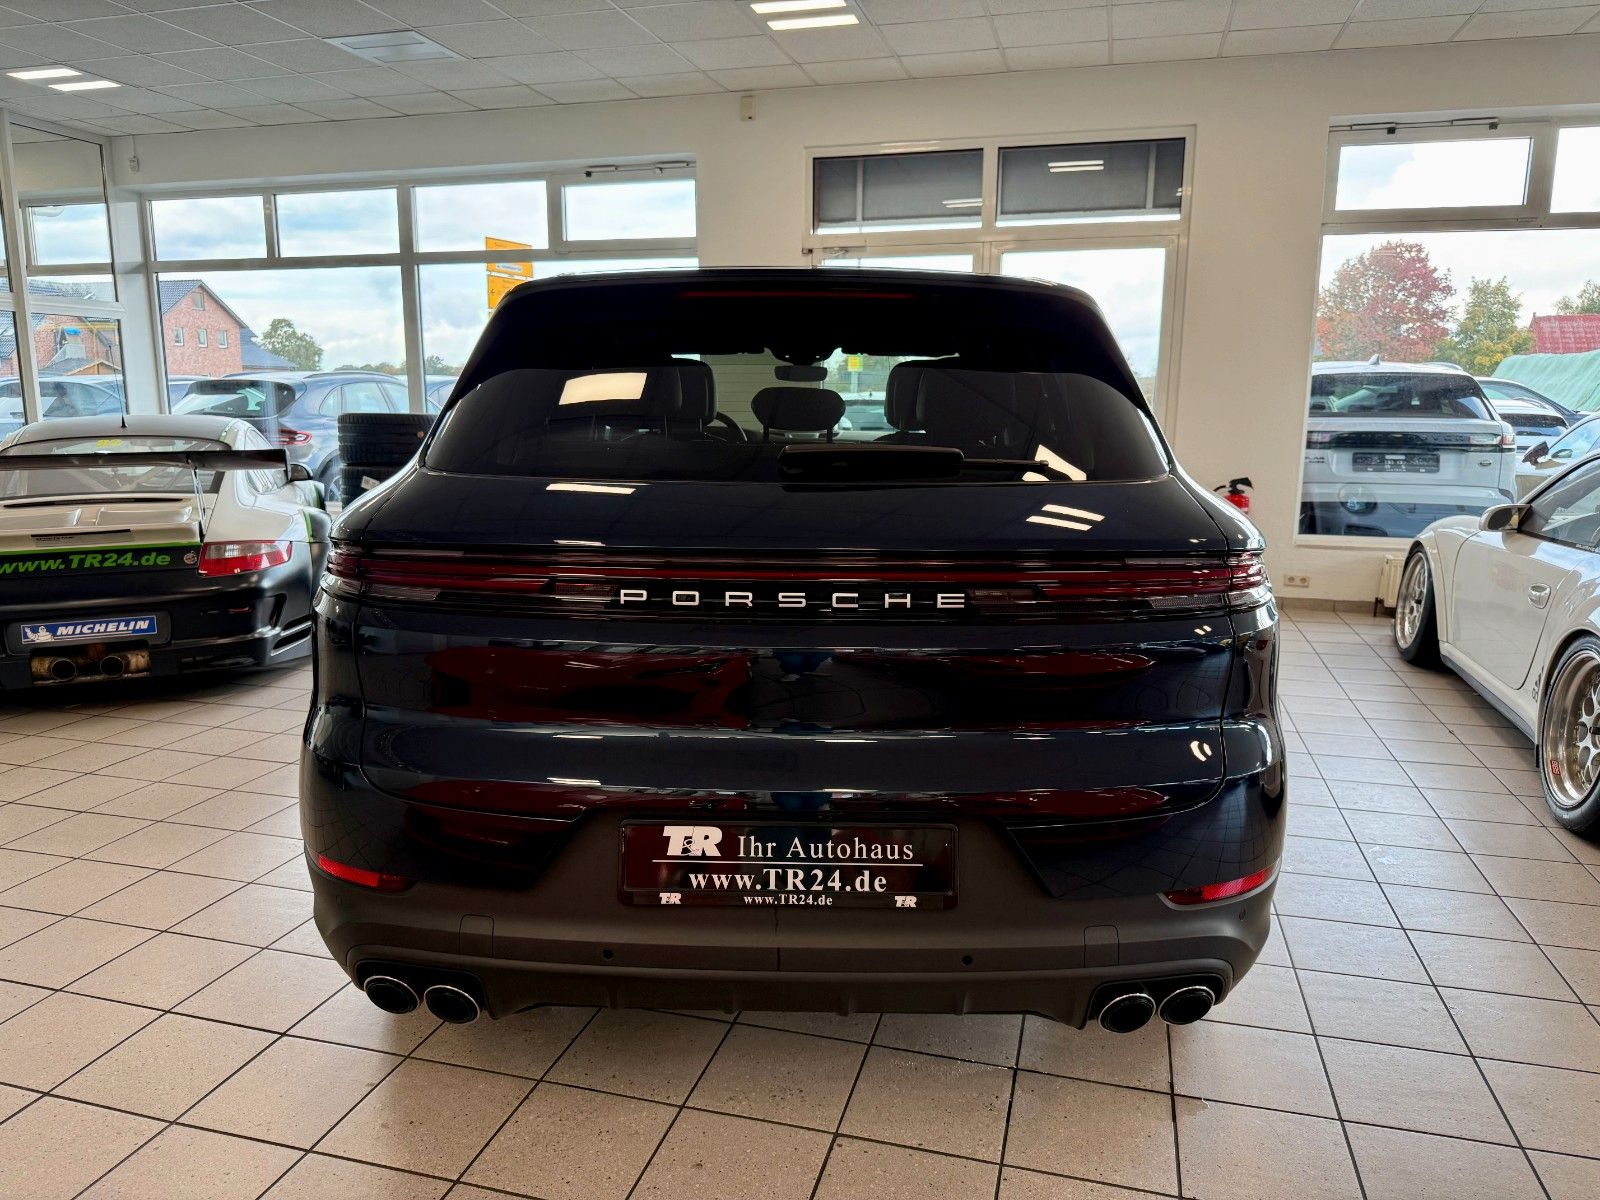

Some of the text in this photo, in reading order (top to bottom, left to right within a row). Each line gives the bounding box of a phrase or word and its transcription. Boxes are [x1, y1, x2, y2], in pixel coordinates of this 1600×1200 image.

[0, 552, 171, 575] www.TR24.de
[620, 589, 965, 609] PORSCHE
[56, 620, 150, 636] MICHELIN
[738, 835, 914, 861] Ihr Autohaus
[689, 868, 887, 893] www.TR24.de
[743, 893, 833, 906] www.TR24.de
